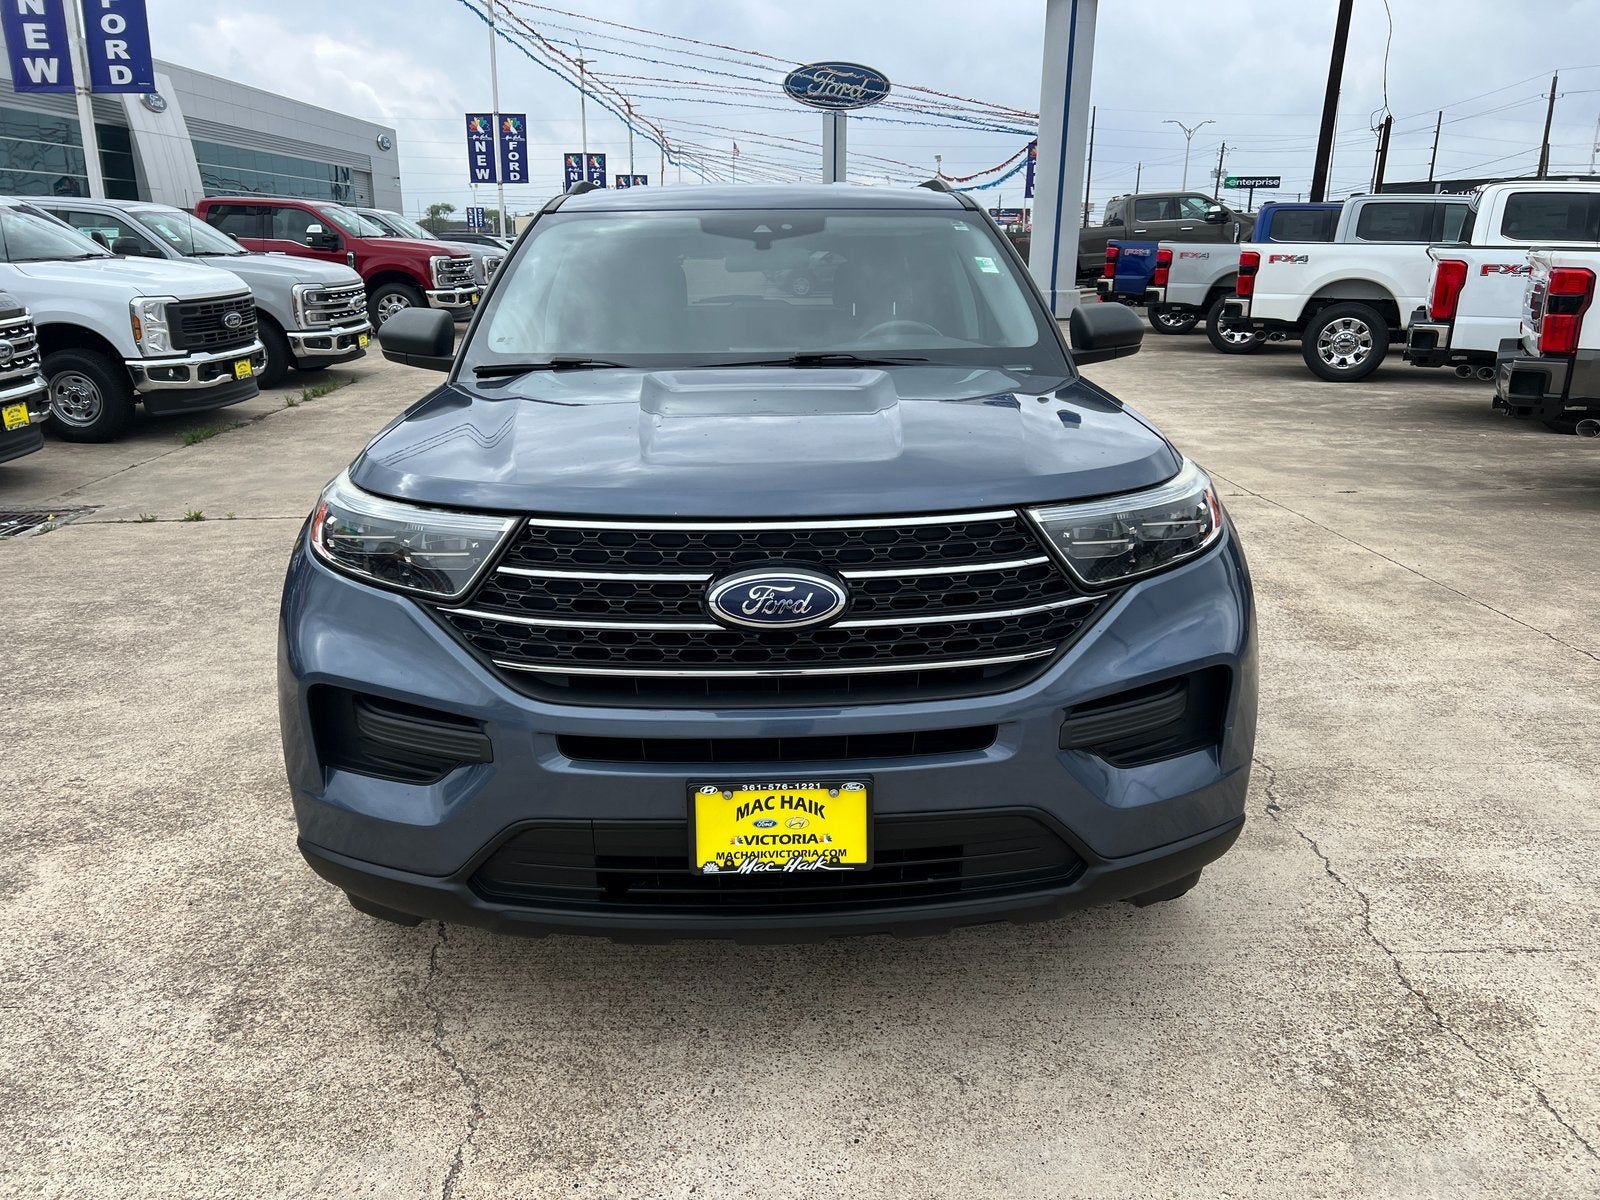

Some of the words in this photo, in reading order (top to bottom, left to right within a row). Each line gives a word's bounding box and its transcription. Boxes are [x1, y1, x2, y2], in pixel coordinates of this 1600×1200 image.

[17, 0, 59, 84] NEW
[806, 70, 869, 98] Ford
[475, 141, 490, 180] NEW
[508, 141, 521, 181] FORD
[1226, 177, 1280, 188] enterprise
[1179, 252, 1210, 260] FX4
[1268, 254, 1309, 264] FX4
[741, 585, 814, 615] Ford
[741, 782, 822, 791] 361-576-1221
[735, 795, 776, 822] MAC
[780, 795, 826, 820] HAIK
[743, 833, 819, 846] VICTORIA
[737, 857, 780, 874] Mac
[783, 856, 840, 873] Haik
